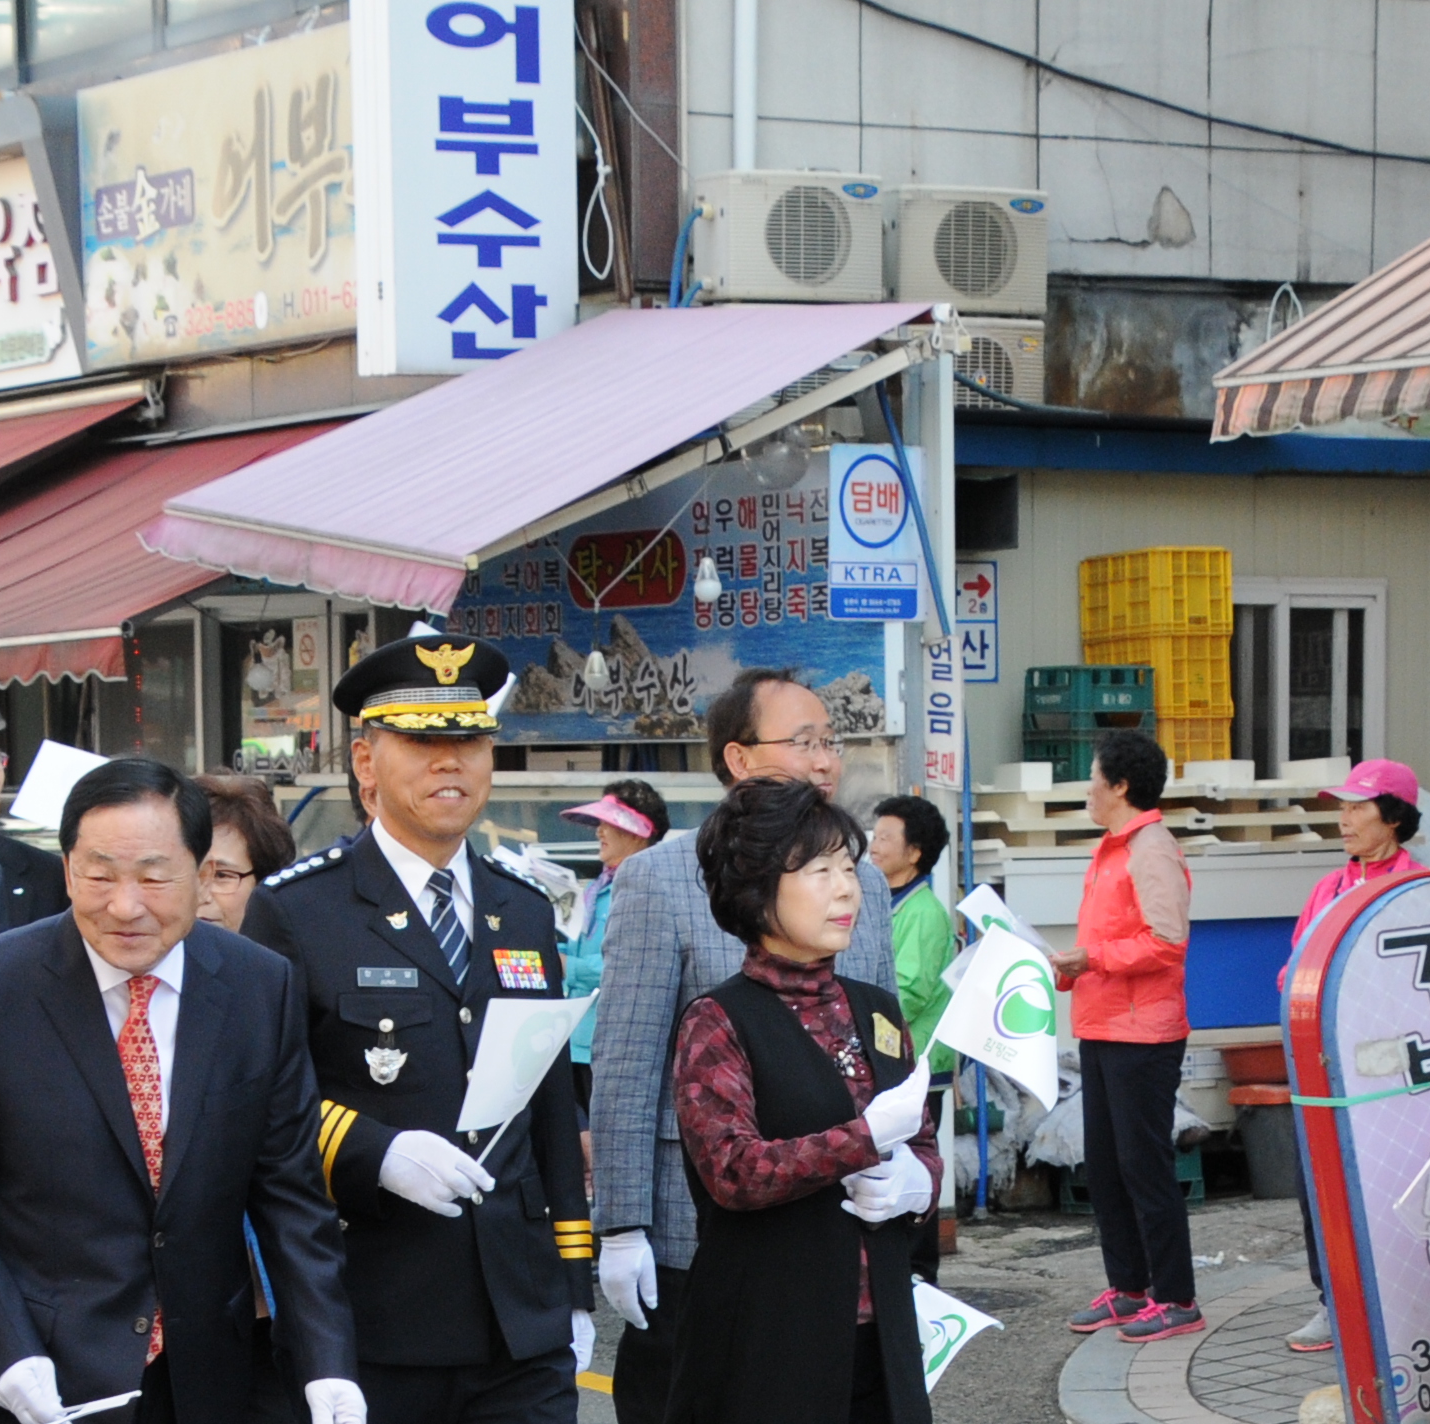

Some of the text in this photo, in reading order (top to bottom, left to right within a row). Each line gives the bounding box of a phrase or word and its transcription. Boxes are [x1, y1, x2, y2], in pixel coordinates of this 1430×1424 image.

[212, 70, 354, 270] 어부
[425, 0, 548, 360] 어부수산
[185, 291, 269, 336] 323-885
[715, 498, 736, 627] 우럭탕
[737, 495, 759, 626] 해물탕
[761, 492, 782, 621] 민어지리탕
[786, 490, 806, 618] 낙지죽
[850, 481, 901, 516] 담배
[843, 565, 902, 583] KTRA
[925, 749, 956, 783] 판매
